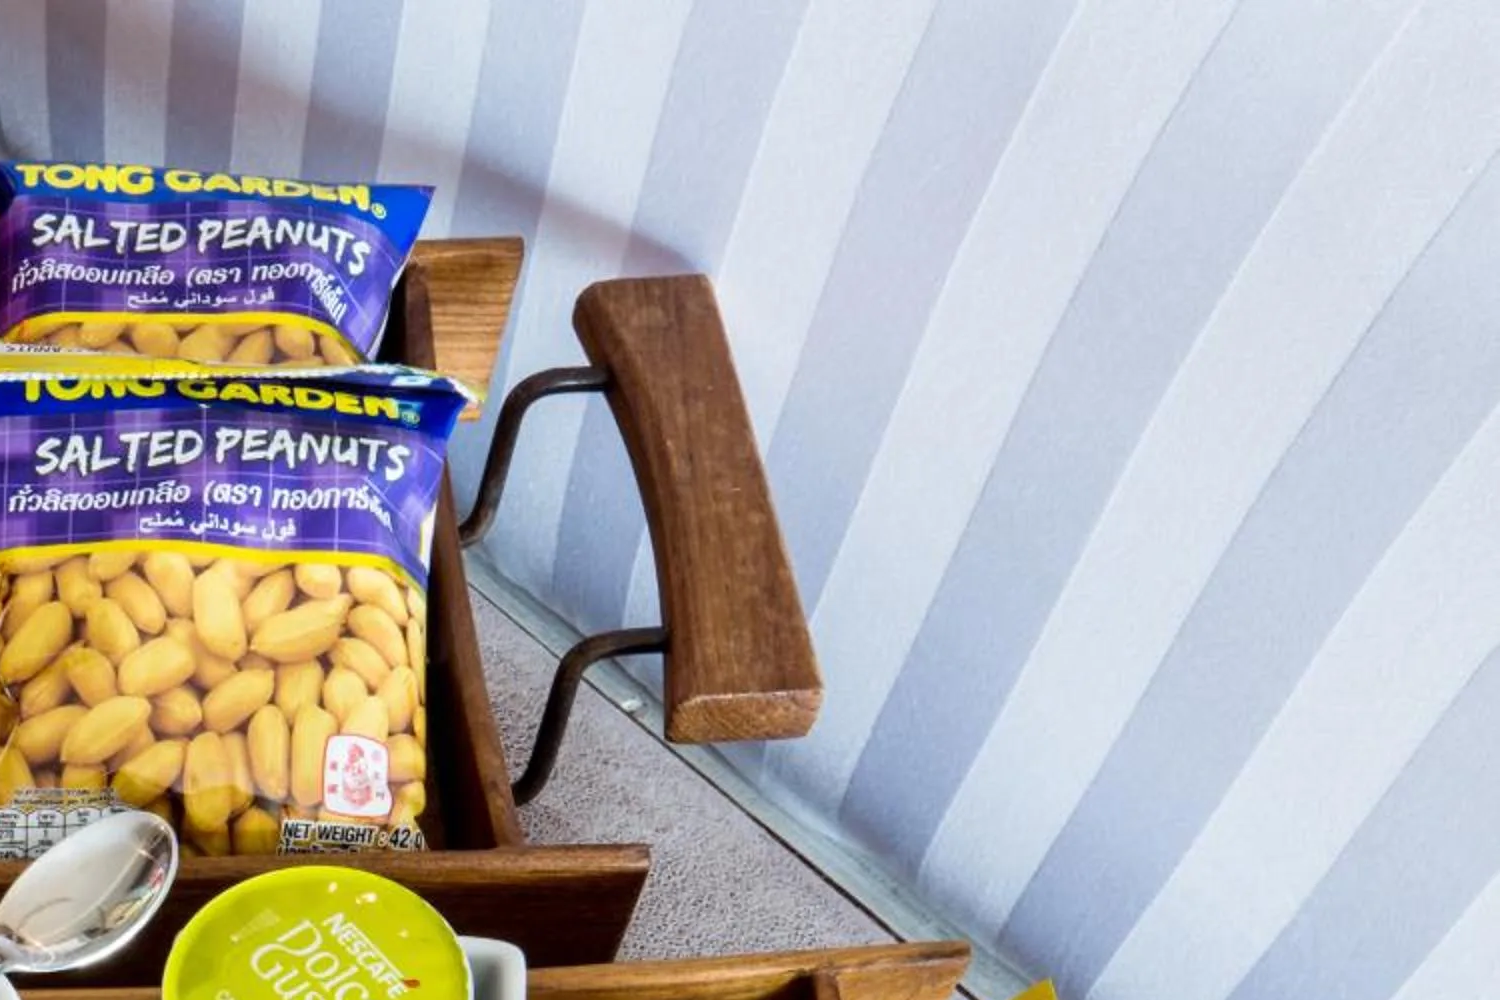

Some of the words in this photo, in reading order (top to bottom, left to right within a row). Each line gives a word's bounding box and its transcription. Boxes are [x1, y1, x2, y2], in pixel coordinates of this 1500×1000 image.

[16, 164, 153, 194] TONG
[33, 214, 188, 254] SALTED
[199, 216, 373, 275] PEANUTS
[36, 430, 203, 476] SALTED
[216, 429, 411, 481] PEANUTS
[284, 823, 311, 838] NET
[318, 823, 376, 843] WEIGHT
[389, 828, 411, 848] 42
